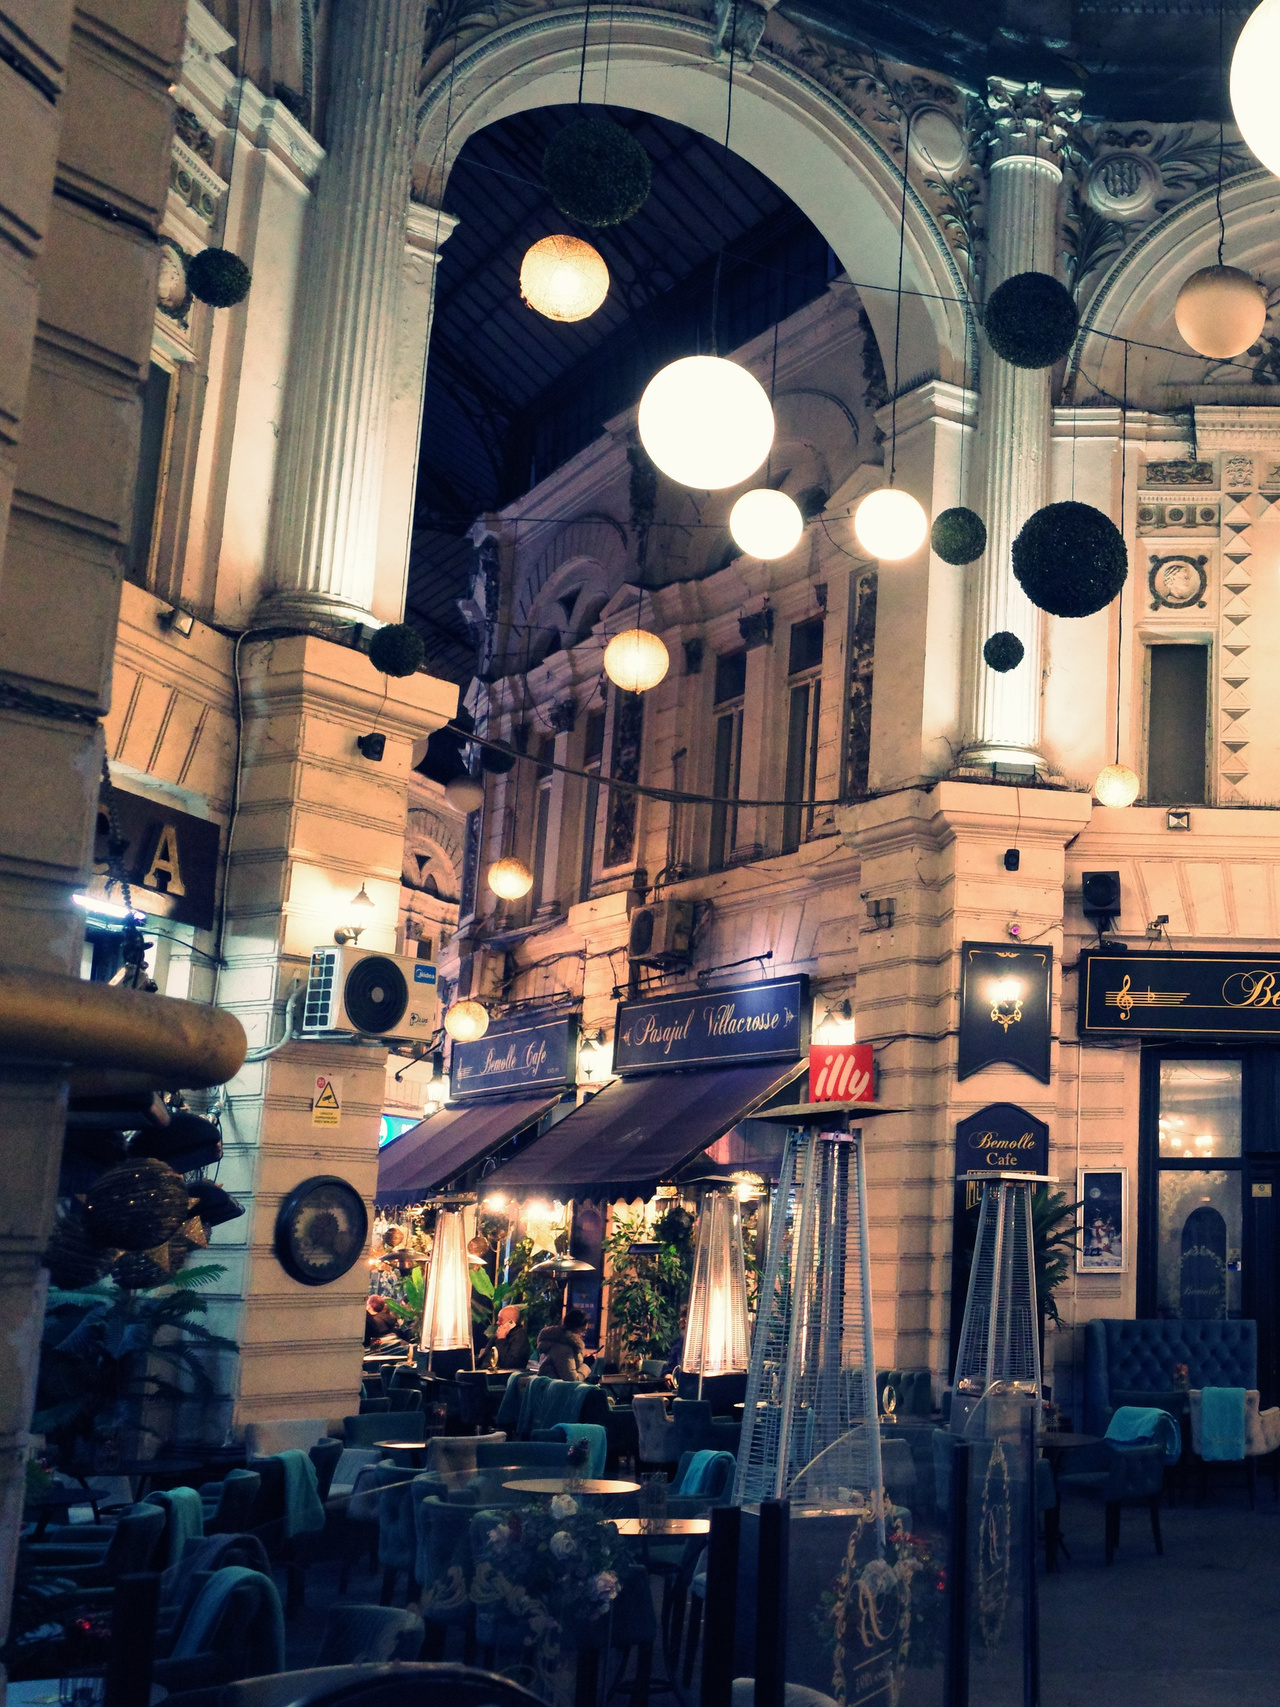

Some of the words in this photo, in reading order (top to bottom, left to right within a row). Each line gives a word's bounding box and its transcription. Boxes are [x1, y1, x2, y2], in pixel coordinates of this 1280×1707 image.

[634, 1008, 695, 1054] Pasajul
[703, 1003, 782, 1038] Villacrosse
[482, 1043, 517, 1074] Bemolle
[522, 1040, 547, 1077] Cafe
[815, 1053, 870, 1102] illy
[968, 1131, 1037, 1150] Bemolle
[986, 1152, 1018, 1166] Cafe
